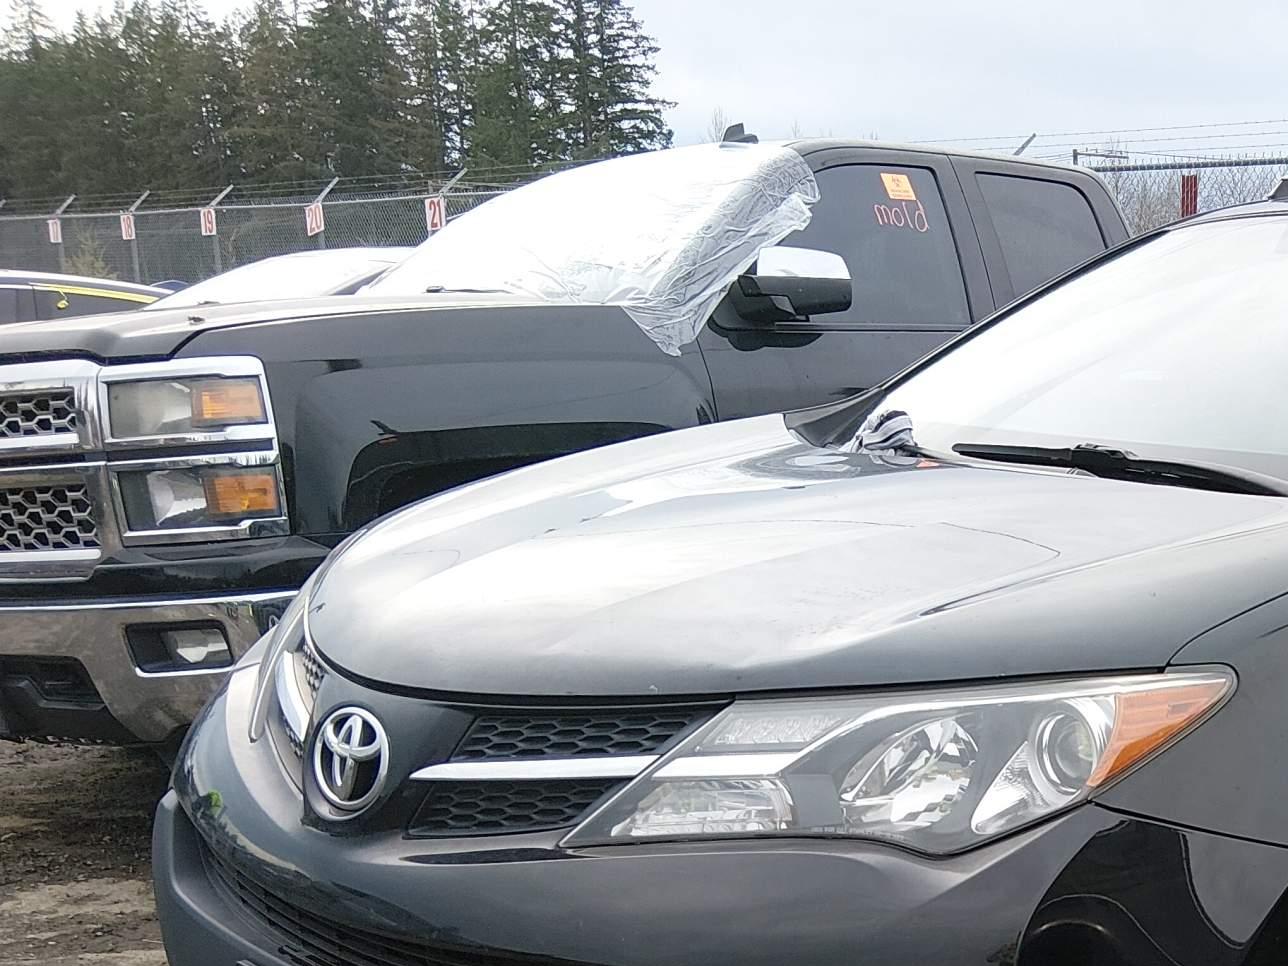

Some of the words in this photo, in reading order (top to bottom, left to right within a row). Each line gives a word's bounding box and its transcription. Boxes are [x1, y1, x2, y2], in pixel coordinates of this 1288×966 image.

[122, 215, 133, 239] 18
[203, 209, 214, 233] 19
[307, 203, 323, 234] 20
[428, 199, 442, 229] 21
[873, 200, 930, 232] mold
